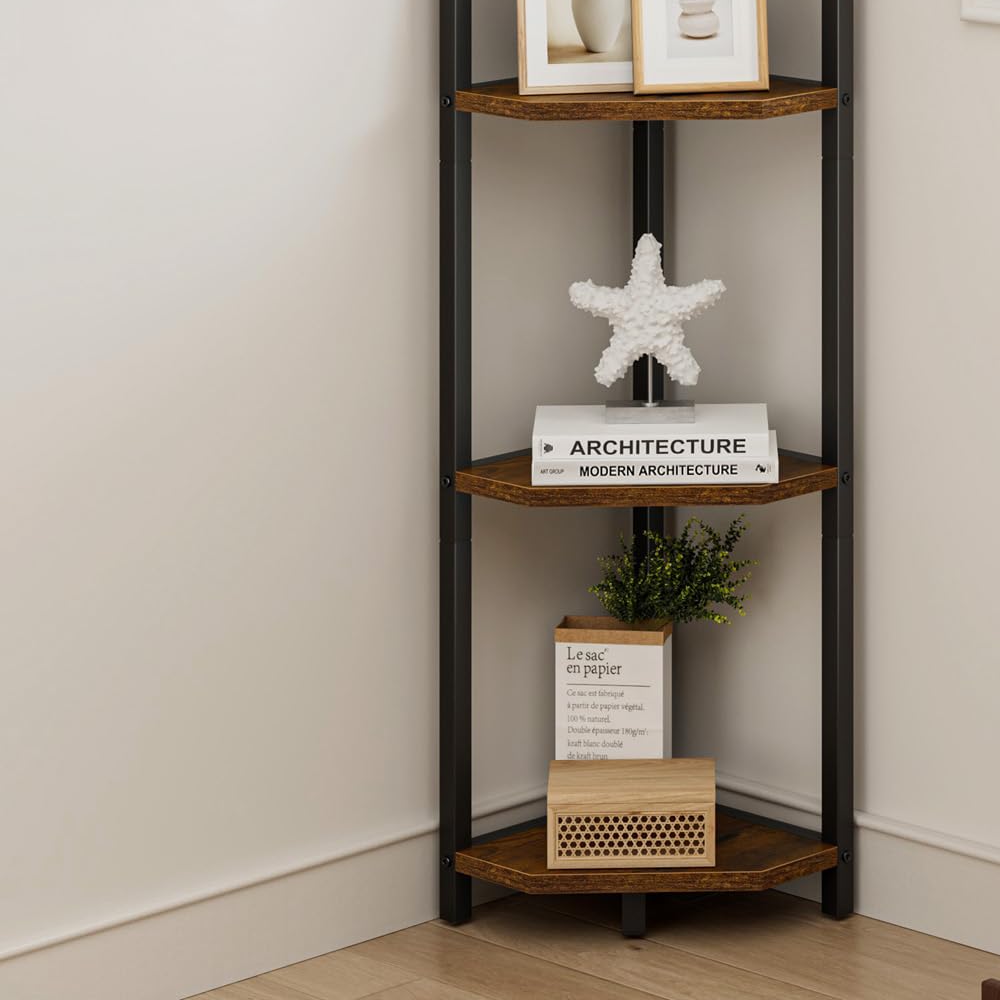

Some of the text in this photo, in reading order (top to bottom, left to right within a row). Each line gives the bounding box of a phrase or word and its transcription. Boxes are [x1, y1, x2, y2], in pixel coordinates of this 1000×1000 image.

[570, 438, 746, 455] ARCHITECTURE
[580, 464, 738, 477] MODERN ARCHITECTURE
[567, 646, 583, 660] Le
[566, 662, 622, 679] en papier
[572, 703, 589, 711] partir
[600, 703, 619, 712] papier
[568, 726, 591, 734] Double
[577, 752, 591, 760] kraft
